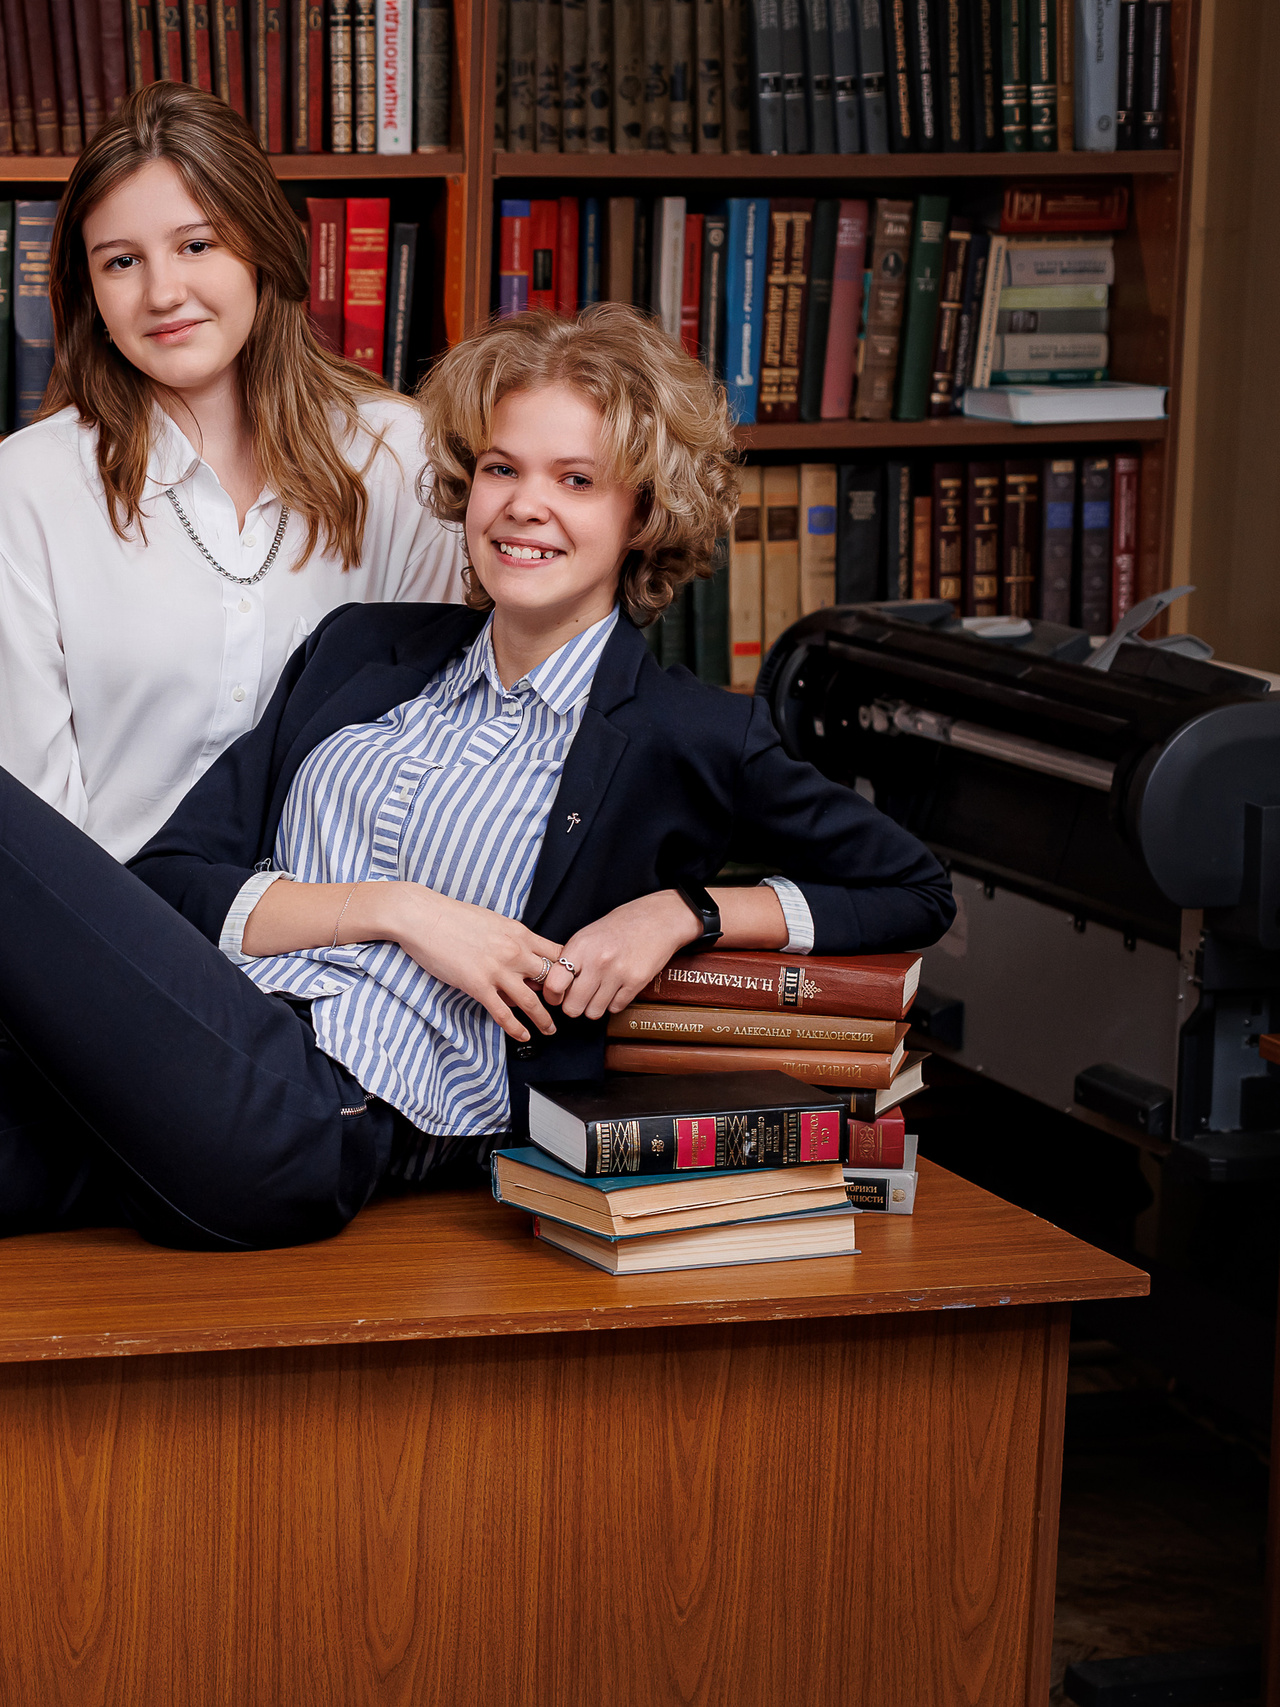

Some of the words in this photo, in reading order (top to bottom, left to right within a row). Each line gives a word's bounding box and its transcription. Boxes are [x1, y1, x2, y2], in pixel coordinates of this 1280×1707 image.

[640, 1021, 704, 1033] ШАХЕРМАЙР
[733, 1026, 792, 1038] АЛЕКСАНДР
[796, 1029, 874, 1043] МАКЕДОНСКИЙ
[782, 1062, 810, 1074] ТИТ
[814, 1064, 863, 1079] ЛИВИЙ
